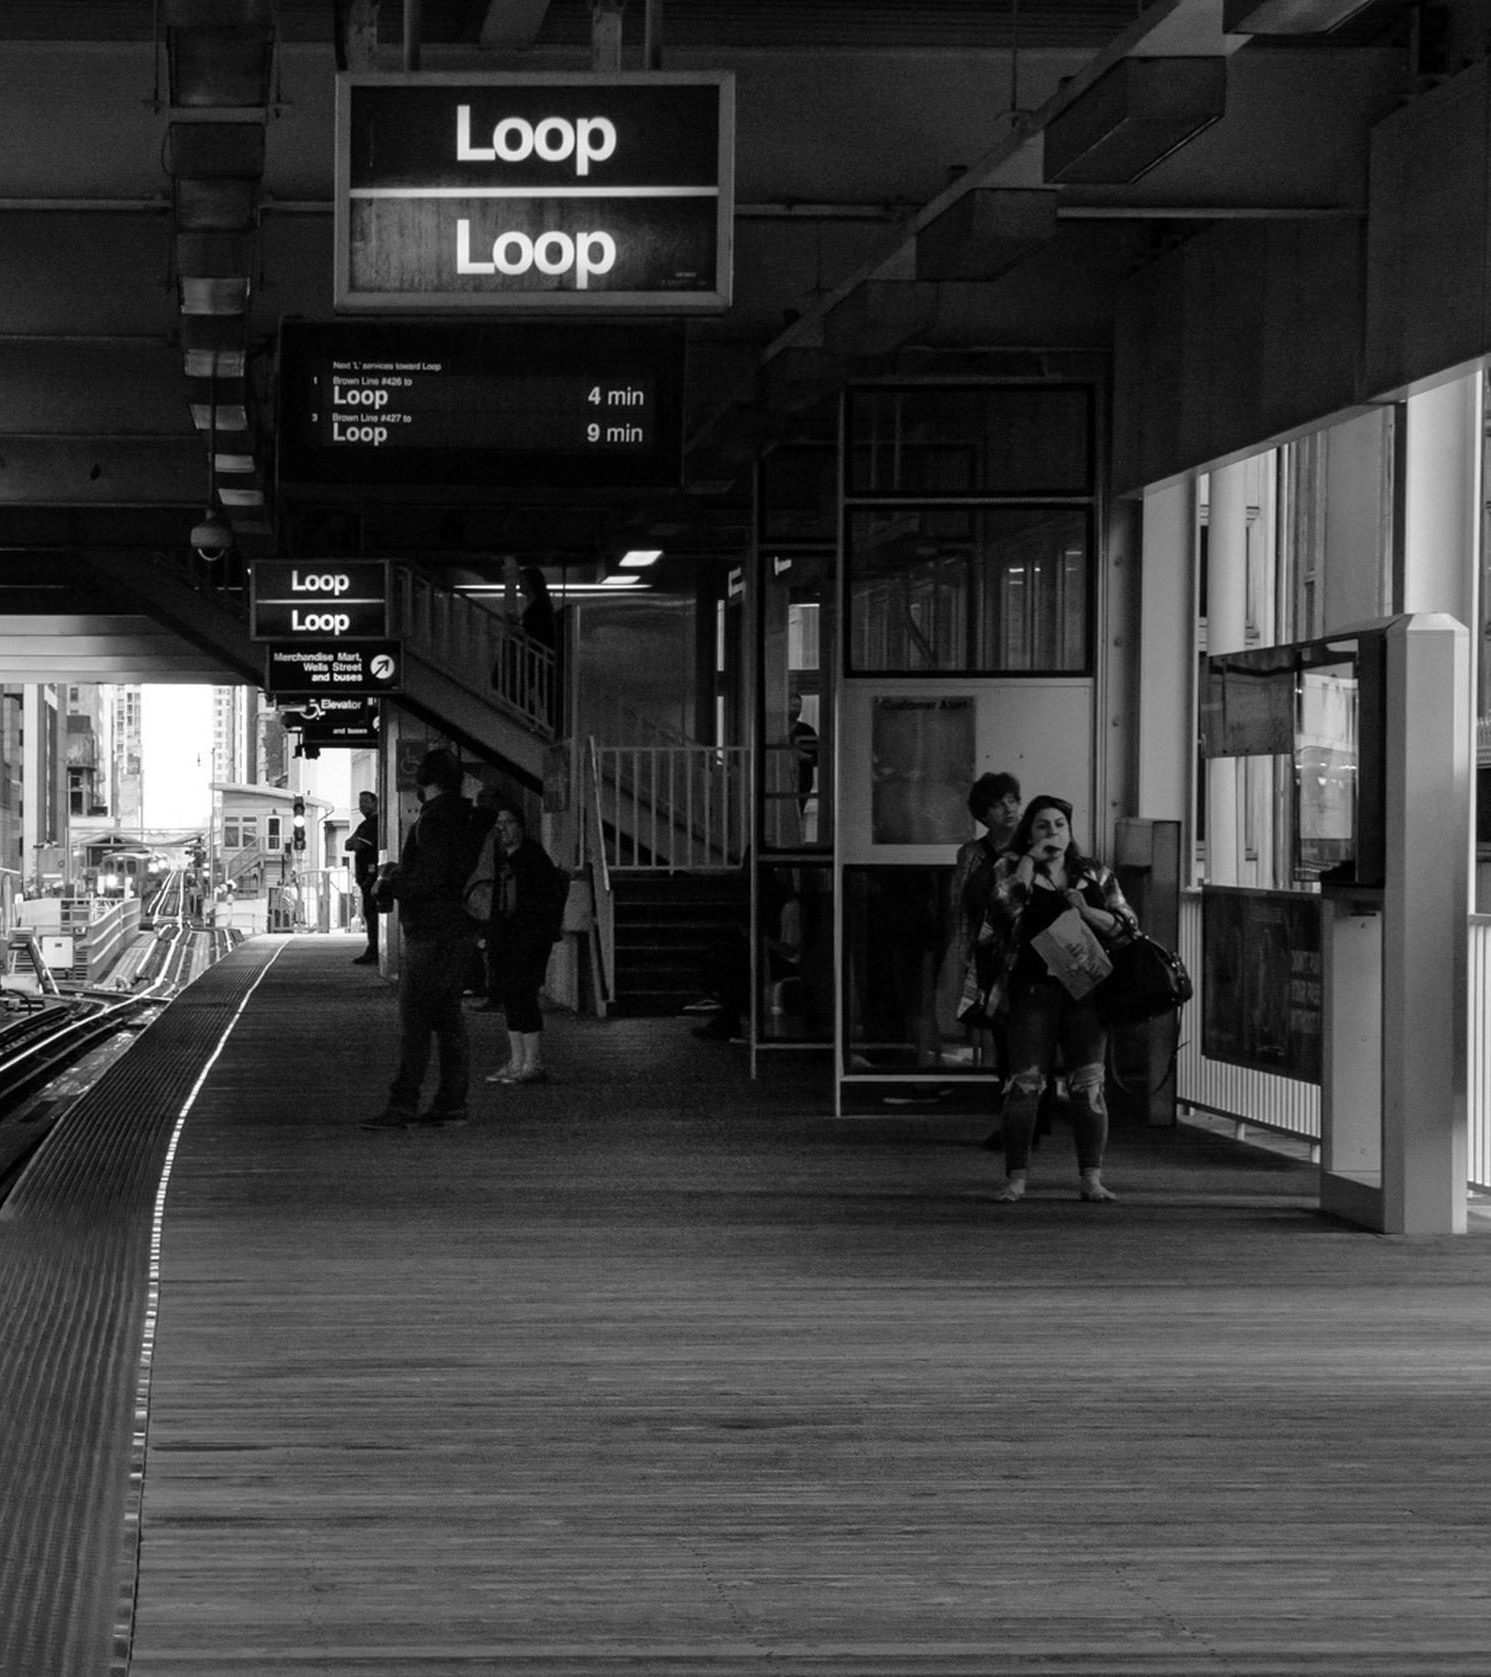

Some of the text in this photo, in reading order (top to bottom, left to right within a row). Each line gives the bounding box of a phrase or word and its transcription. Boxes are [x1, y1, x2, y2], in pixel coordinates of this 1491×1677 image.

[456, 104, 617, 176] Loop
[455, 218, 616, 290] Loop
[332, 361, 351, 370] Next
[362, 362, 394, 370] services
[395, 362, 421, 370] toward
[422, 362, 442, 372] Loop
[313, 375, 318, 385] 1
[332, 375, 360, 386] Brown
[360, 375, 380, 386] Line
[403, 377, 413, 386] to
[333, 385, 389, 410] Loop
[587, 386, 645, 406] 4 min
[332, 412, 359, 422] Brown
[360, 412, 379, 423] Line
[380, 413, 402, 423] #427
[402, 413, 412, 423] to
[332, 421, 388, 447] Loop
[586, 422, 644, 443] 9 min
[291, 569, 350, 596] Loop
[291, 609, 350, 636] Loop
[273, 651, 363, 663] Merchandise Mart,
[302, 661, 362, 672] Wells Street
[311, 671, 363, 682] and buses
[320, 698, 362, 710] Elevator
[881, 699, 967, 711] Customer Alert
